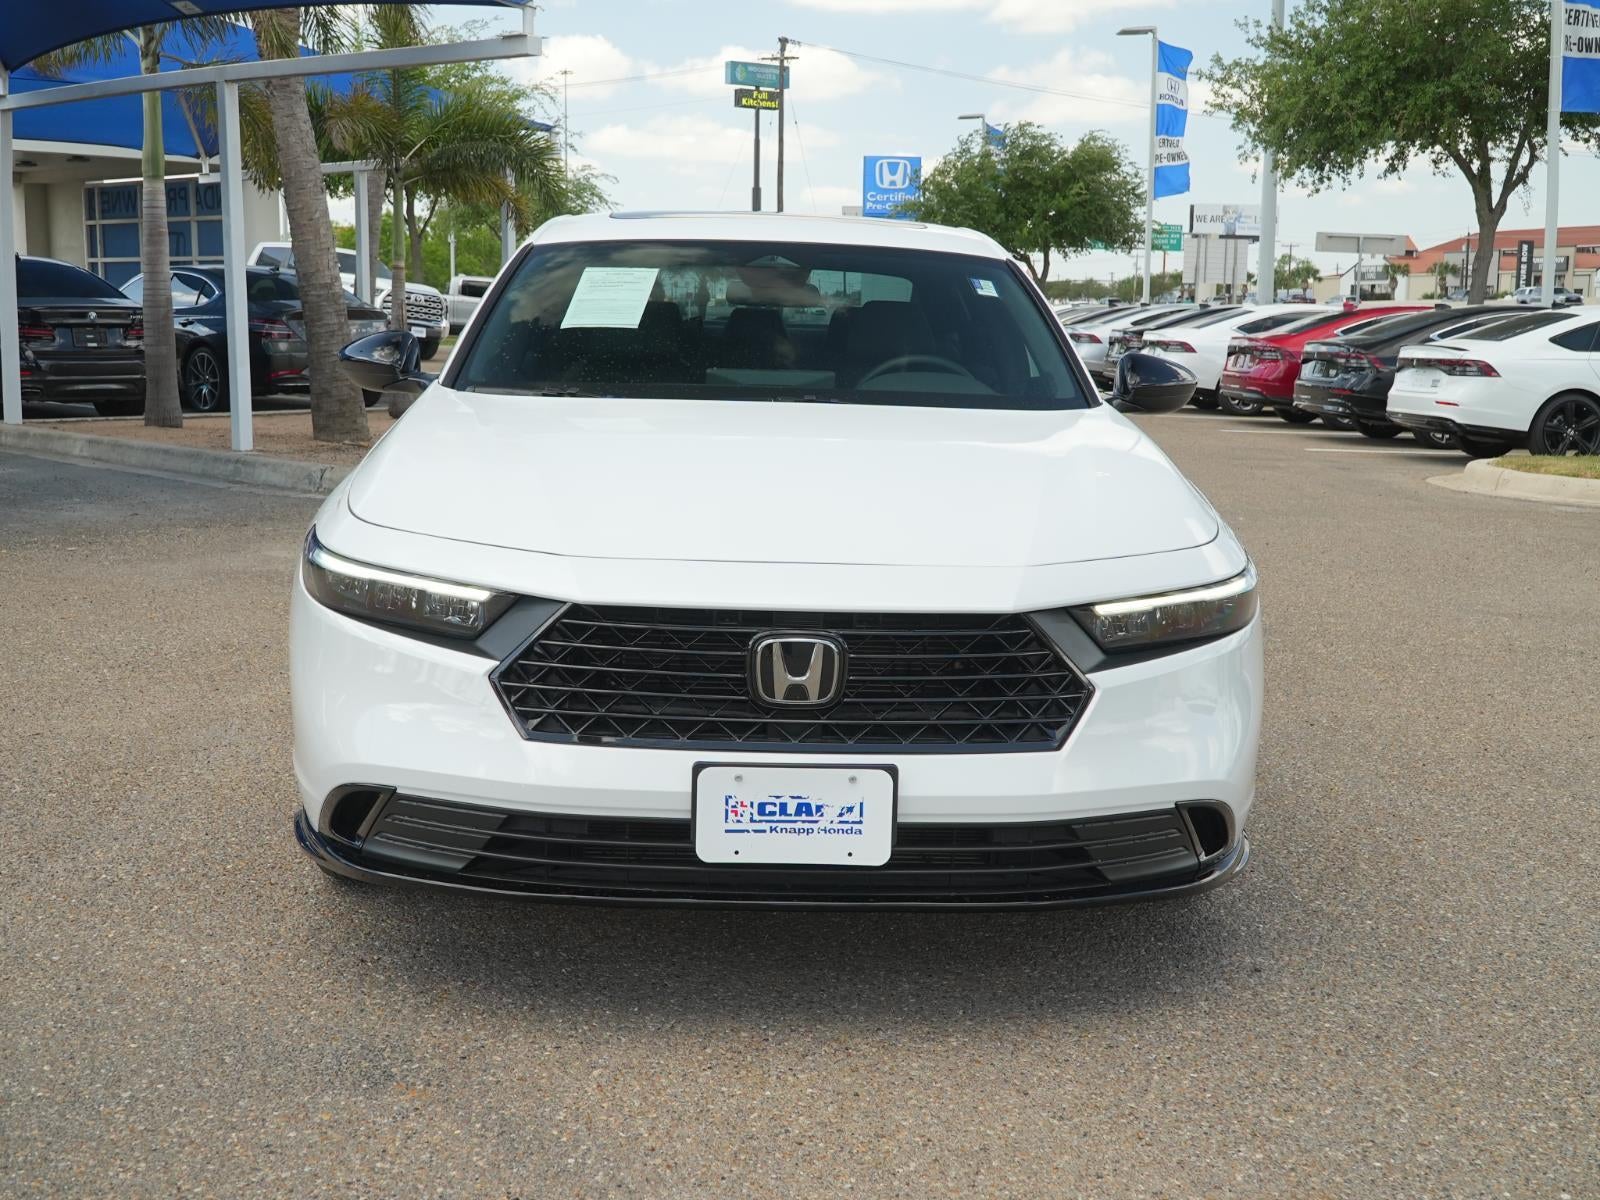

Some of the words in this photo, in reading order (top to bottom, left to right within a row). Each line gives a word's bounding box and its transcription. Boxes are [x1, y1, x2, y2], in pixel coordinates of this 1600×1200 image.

[753, 91, 768, 100] Full
[742, 97, 779, 108] Kitchens!
[1195, 215, 1208, 223] WE
[1209, 215, 1225, 224] ARE
[769, 825, 814, 836] Knapp
[818, 826, 863, 835] Honda
